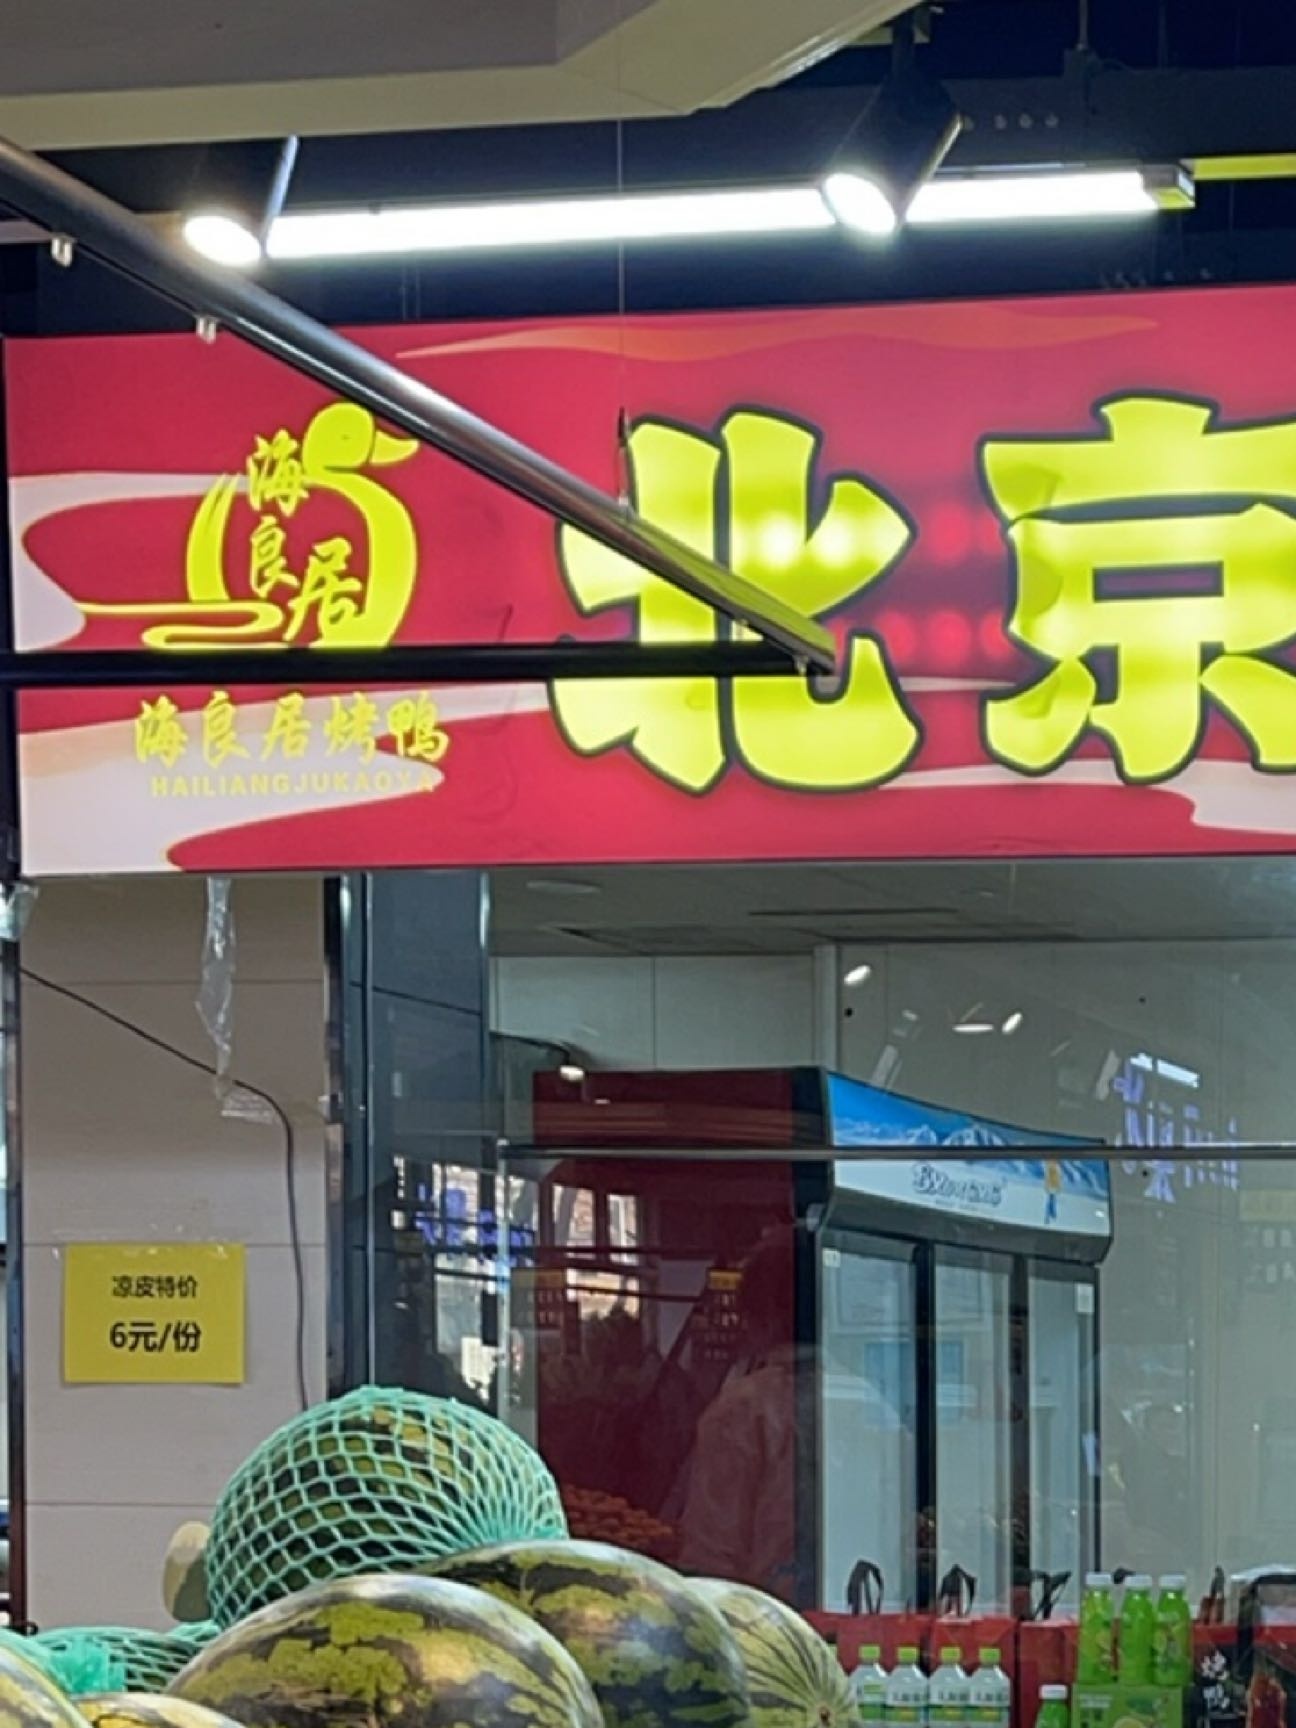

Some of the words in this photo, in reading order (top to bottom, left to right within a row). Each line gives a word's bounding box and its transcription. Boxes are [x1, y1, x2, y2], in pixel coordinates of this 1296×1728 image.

[135, 689, 450, 768] 海良居烤鸭
[112, 1274, 198, 1299] 凉皮特价
[109, 1319, 202, 1353] 6元/份
